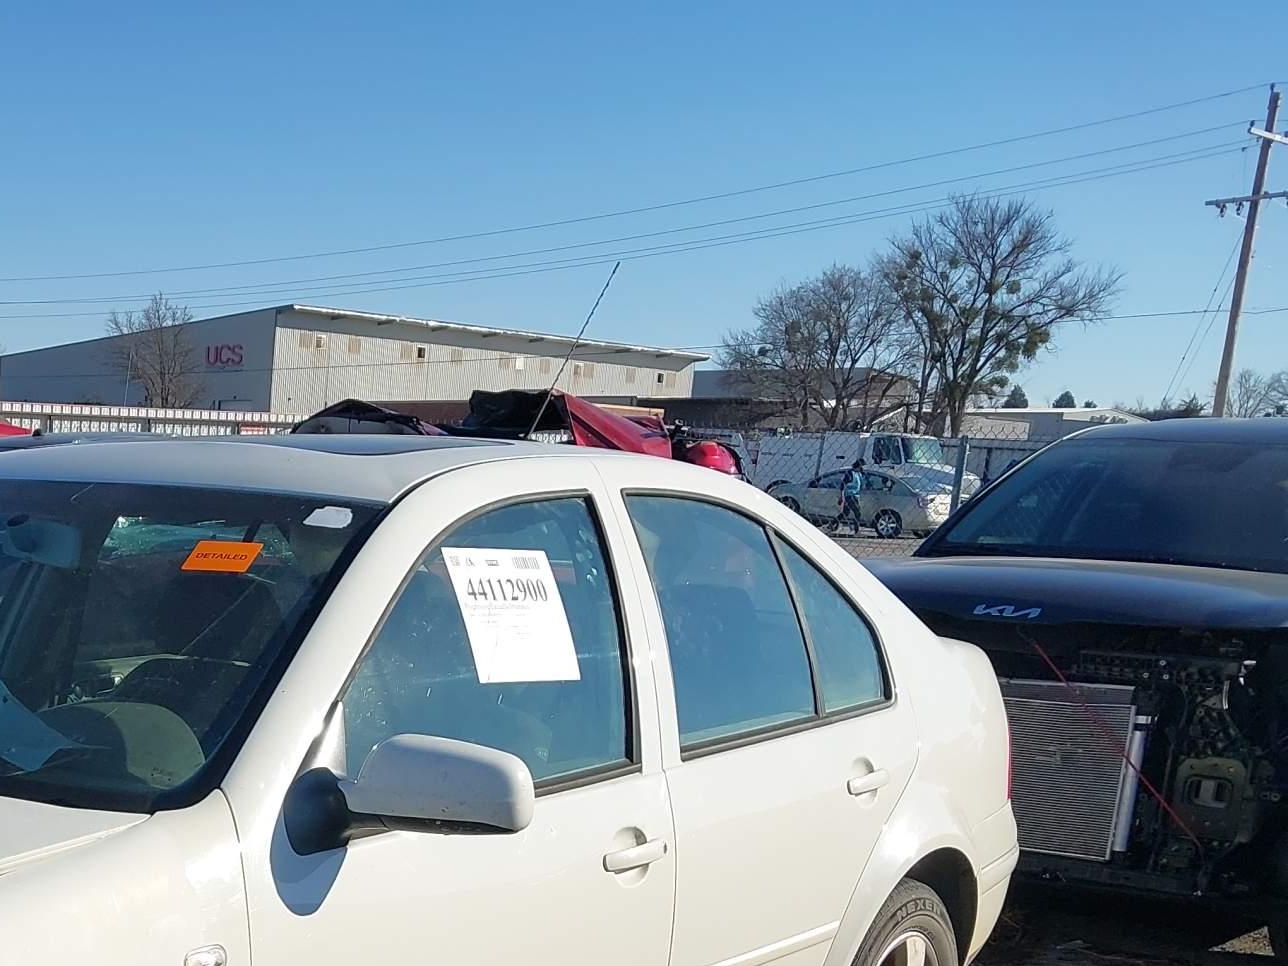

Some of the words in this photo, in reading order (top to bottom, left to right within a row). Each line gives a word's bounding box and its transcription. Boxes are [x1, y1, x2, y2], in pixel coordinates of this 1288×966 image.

[206, 344, 244, 366] UCS
[195, 552, 248, 561] DETAILED
[466, 577, 548, 602] 44112900
[896, 899, 942, 923] NEXEN
